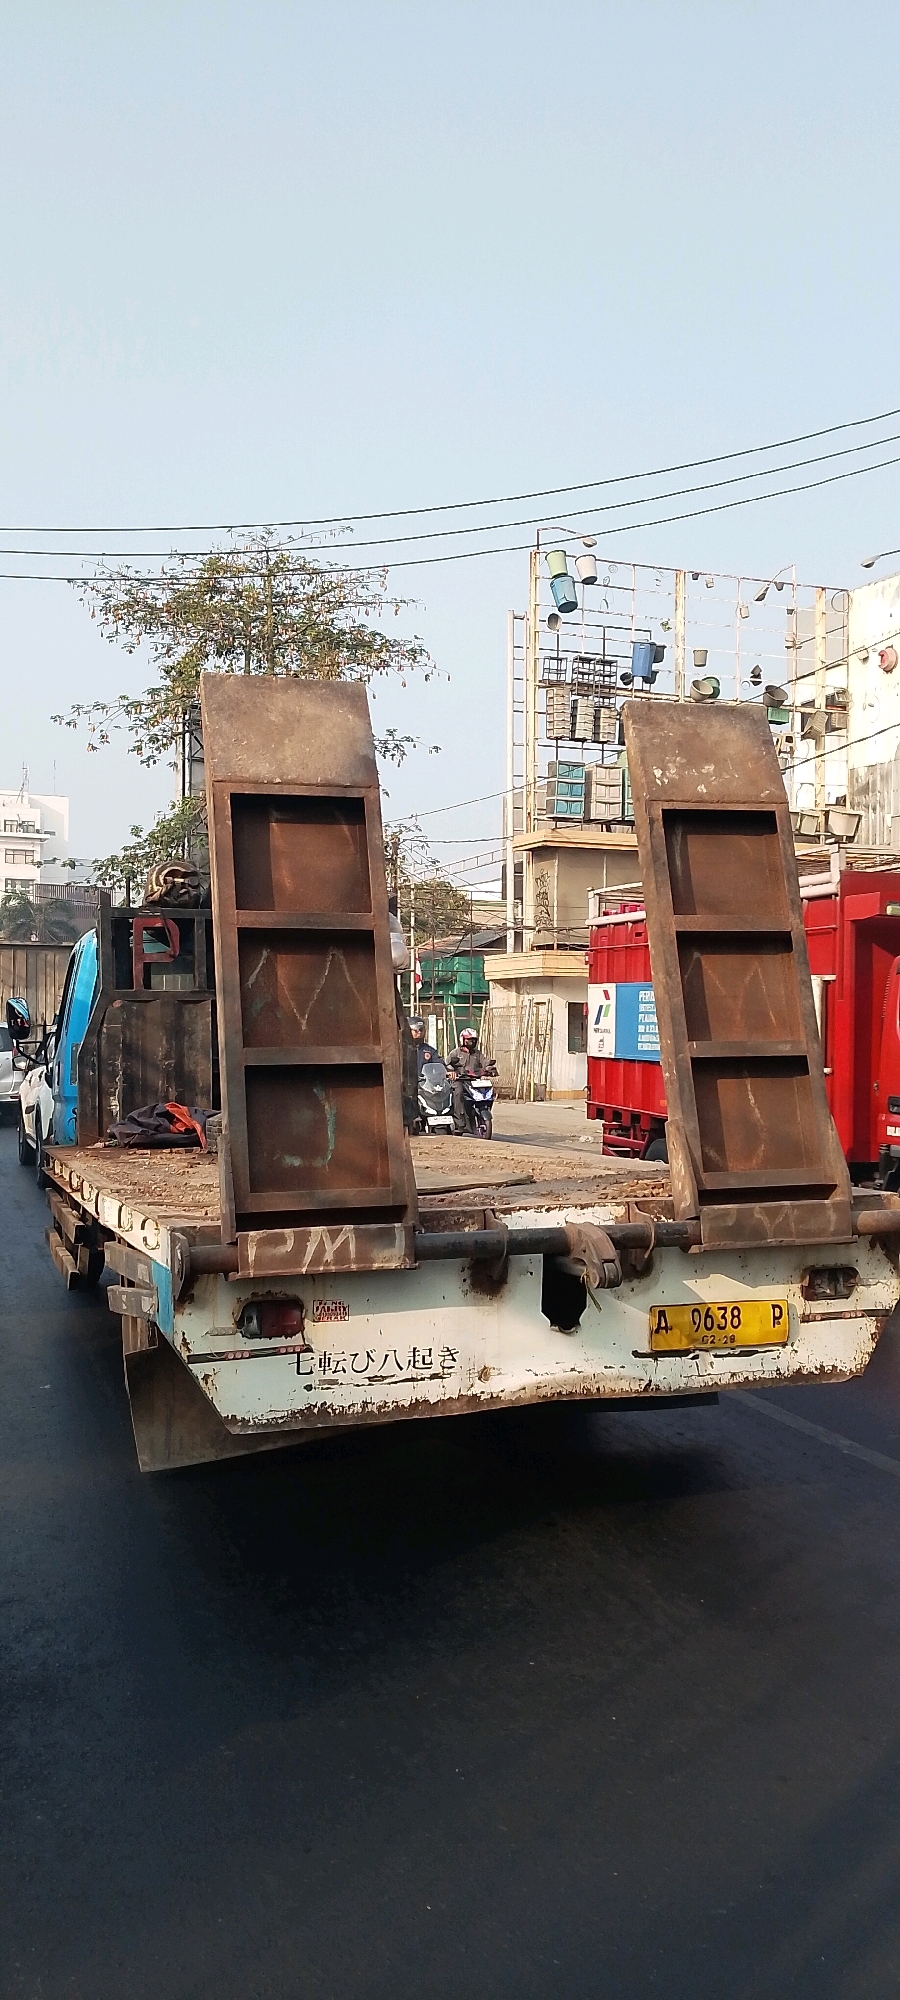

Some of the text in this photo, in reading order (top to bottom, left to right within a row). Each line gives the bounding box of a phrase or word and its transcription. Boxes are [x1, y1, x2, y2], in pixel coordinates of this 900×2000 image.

[654, 1303, 784, 1334] A 9638 P
[288, 1346, 460, 1376] 七転び八起き
